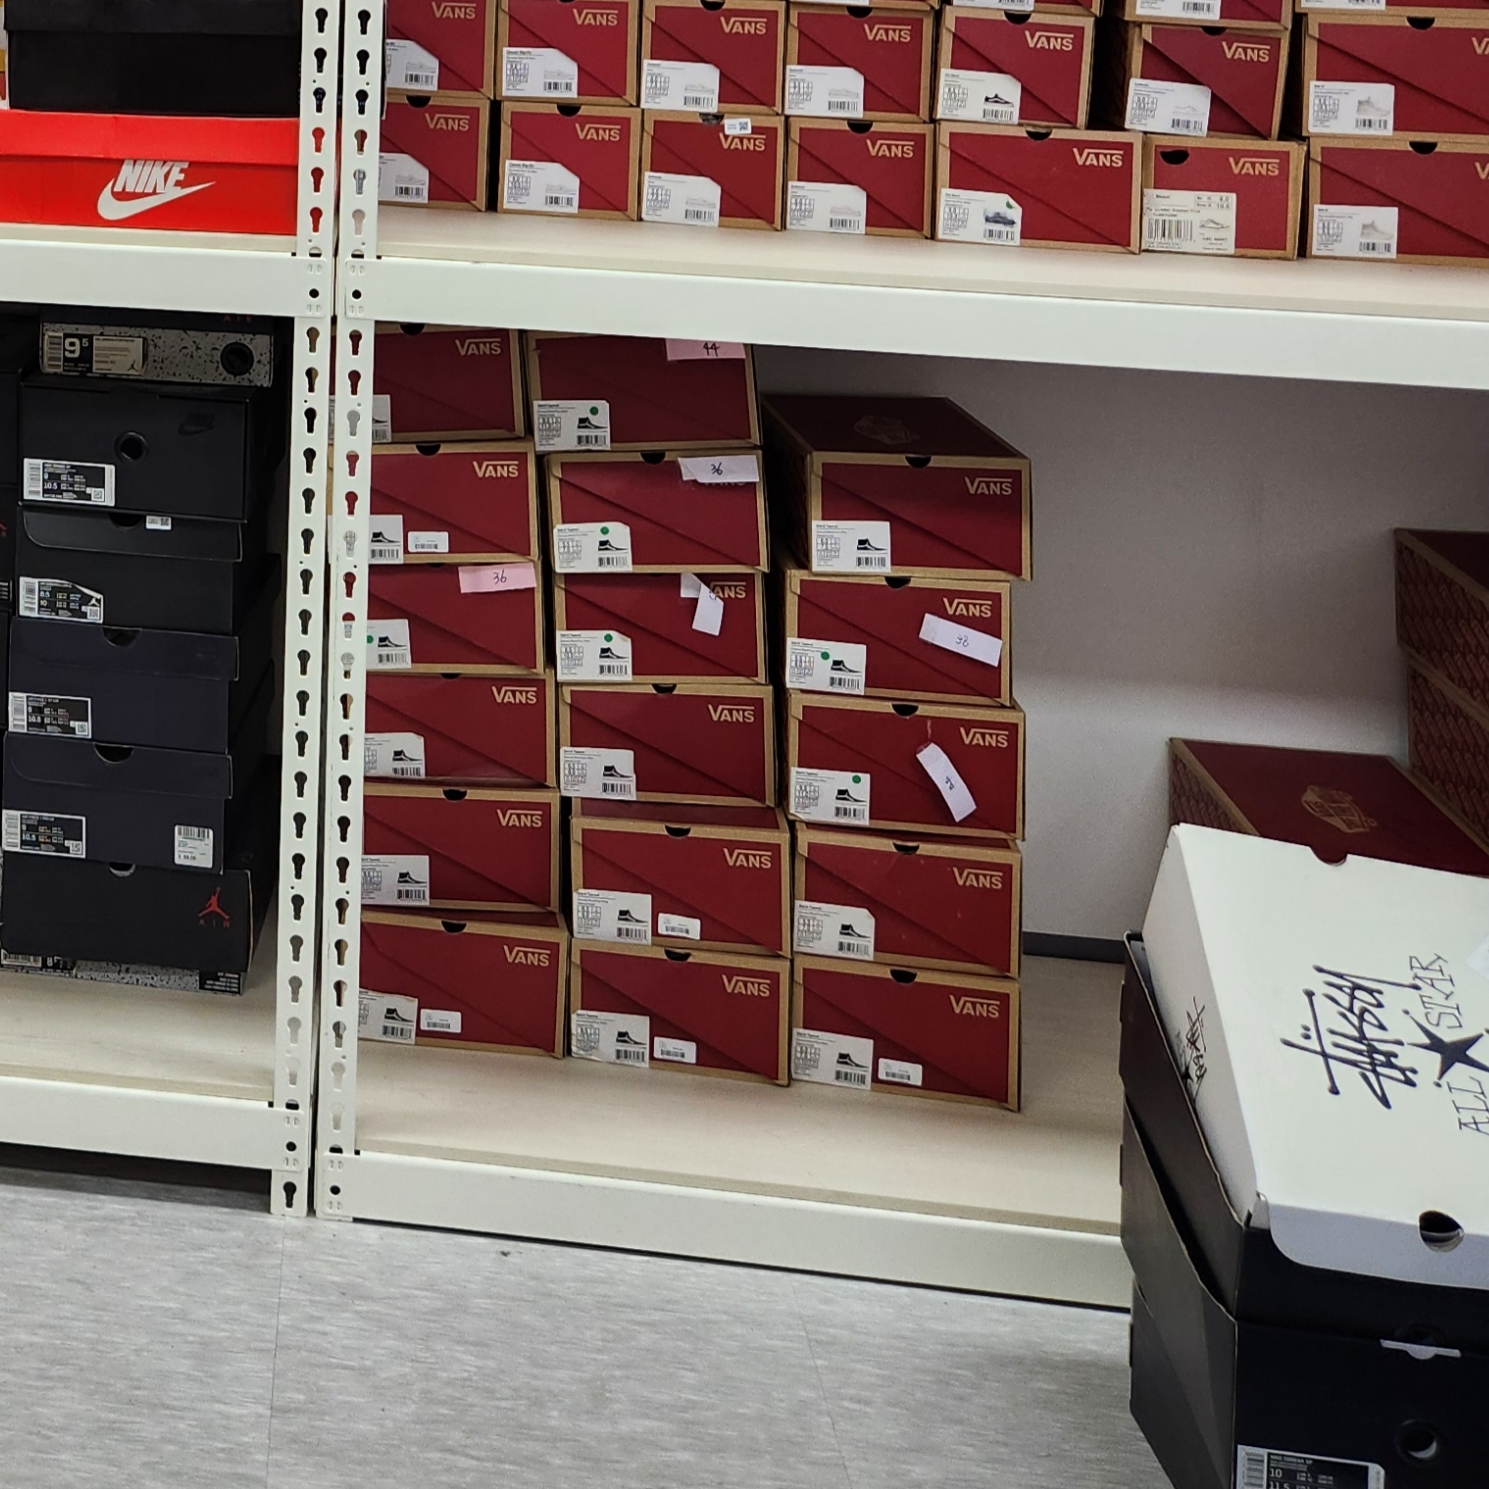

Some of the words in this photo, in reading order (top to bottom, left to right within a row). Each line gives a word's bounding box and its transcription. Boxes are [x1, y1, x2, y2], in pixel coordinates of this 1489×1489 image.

[431, 2, 477, 19] VANS
[573, 9, 619, 27] VANS
[720, 17, 767, 35] VANS
[864, 23, 912, 43] VANS
[1024, 30, 1074, 51] VANS
[1222, 41, 1271, 62] VANS
[424, 113, 470, 131] VANS
[575, 123, 621, 141] VANS
[719, 133, 766, 152] VANS
[866, 140, 915, 159] VANS
[1072, 148, 1124, 168] VANS
[1228, 157, 1280, 176] VANS
[114, 159, 190, 193] NIKE
[454, 338, 502, 356] VANS
[472, 461, 519, 478] VANS
[709, 462, 724, 476] 36
[964, 477, 1012, 496] VANS
[493, 571, 507, 584] 36
[943, 598, 992, 618] VANS
[491, 686, 538, 704] VANS
[708, 704, 755, 724] VANS
[959, 727, 1009, 748] VANS
[496, 809, 543, 828] VANS
[723, 848, 772, 869] VANS
[952, 868, 1003, 889] VANS
[502, 945, 551, 967] VANS
[721, 974, 771, 997] VANS
[1409, 953, 1463, 1029] STAR
[949, 995, 1000, 1018] VANS
[1270, 1469, 1282, 1478] 10
